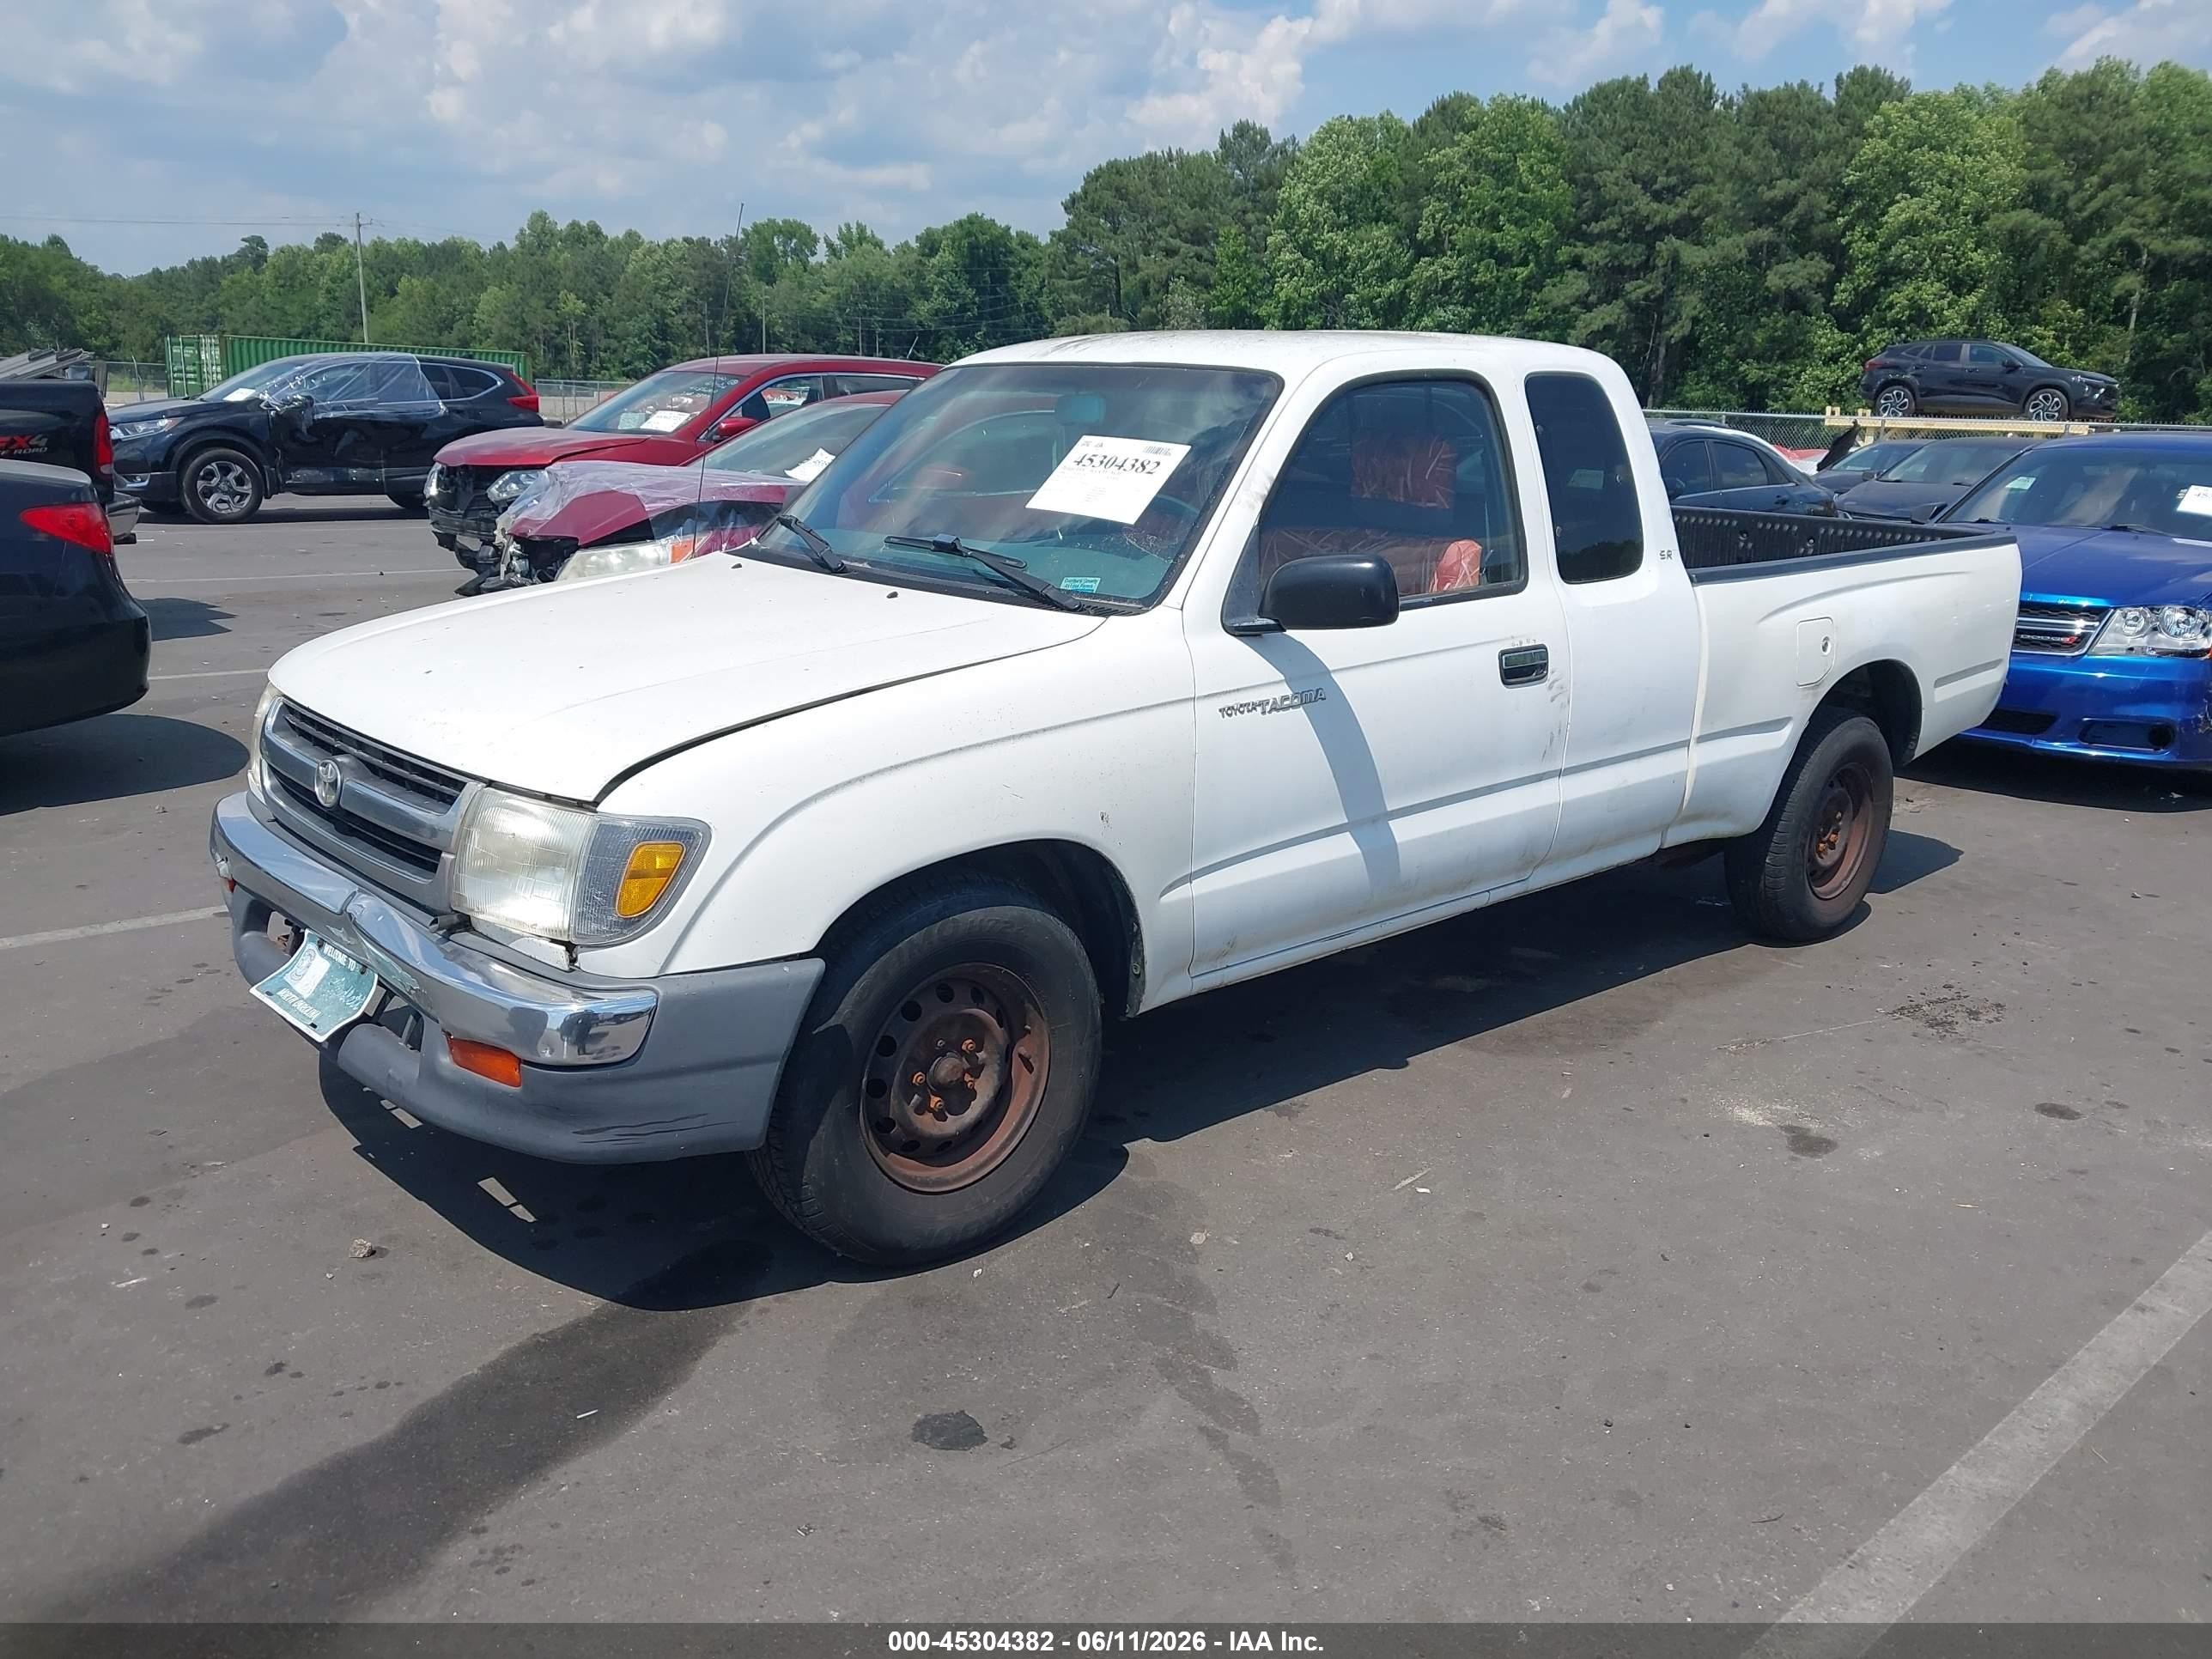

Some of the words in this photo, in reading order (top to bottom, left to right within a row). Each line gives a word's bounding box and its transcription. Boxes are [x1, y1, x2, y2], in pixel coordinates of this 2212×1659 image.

[1073, 453, 1161, 475] 45304382
[1659, 550, 1673, 560] SR
[1218, 701, 1259, 719] TOYOTA
[1259, 687, 1327, 715] TACOMA
[324, 943, 347, 967] WELCOME
[347, 959, 356, 971] TO
